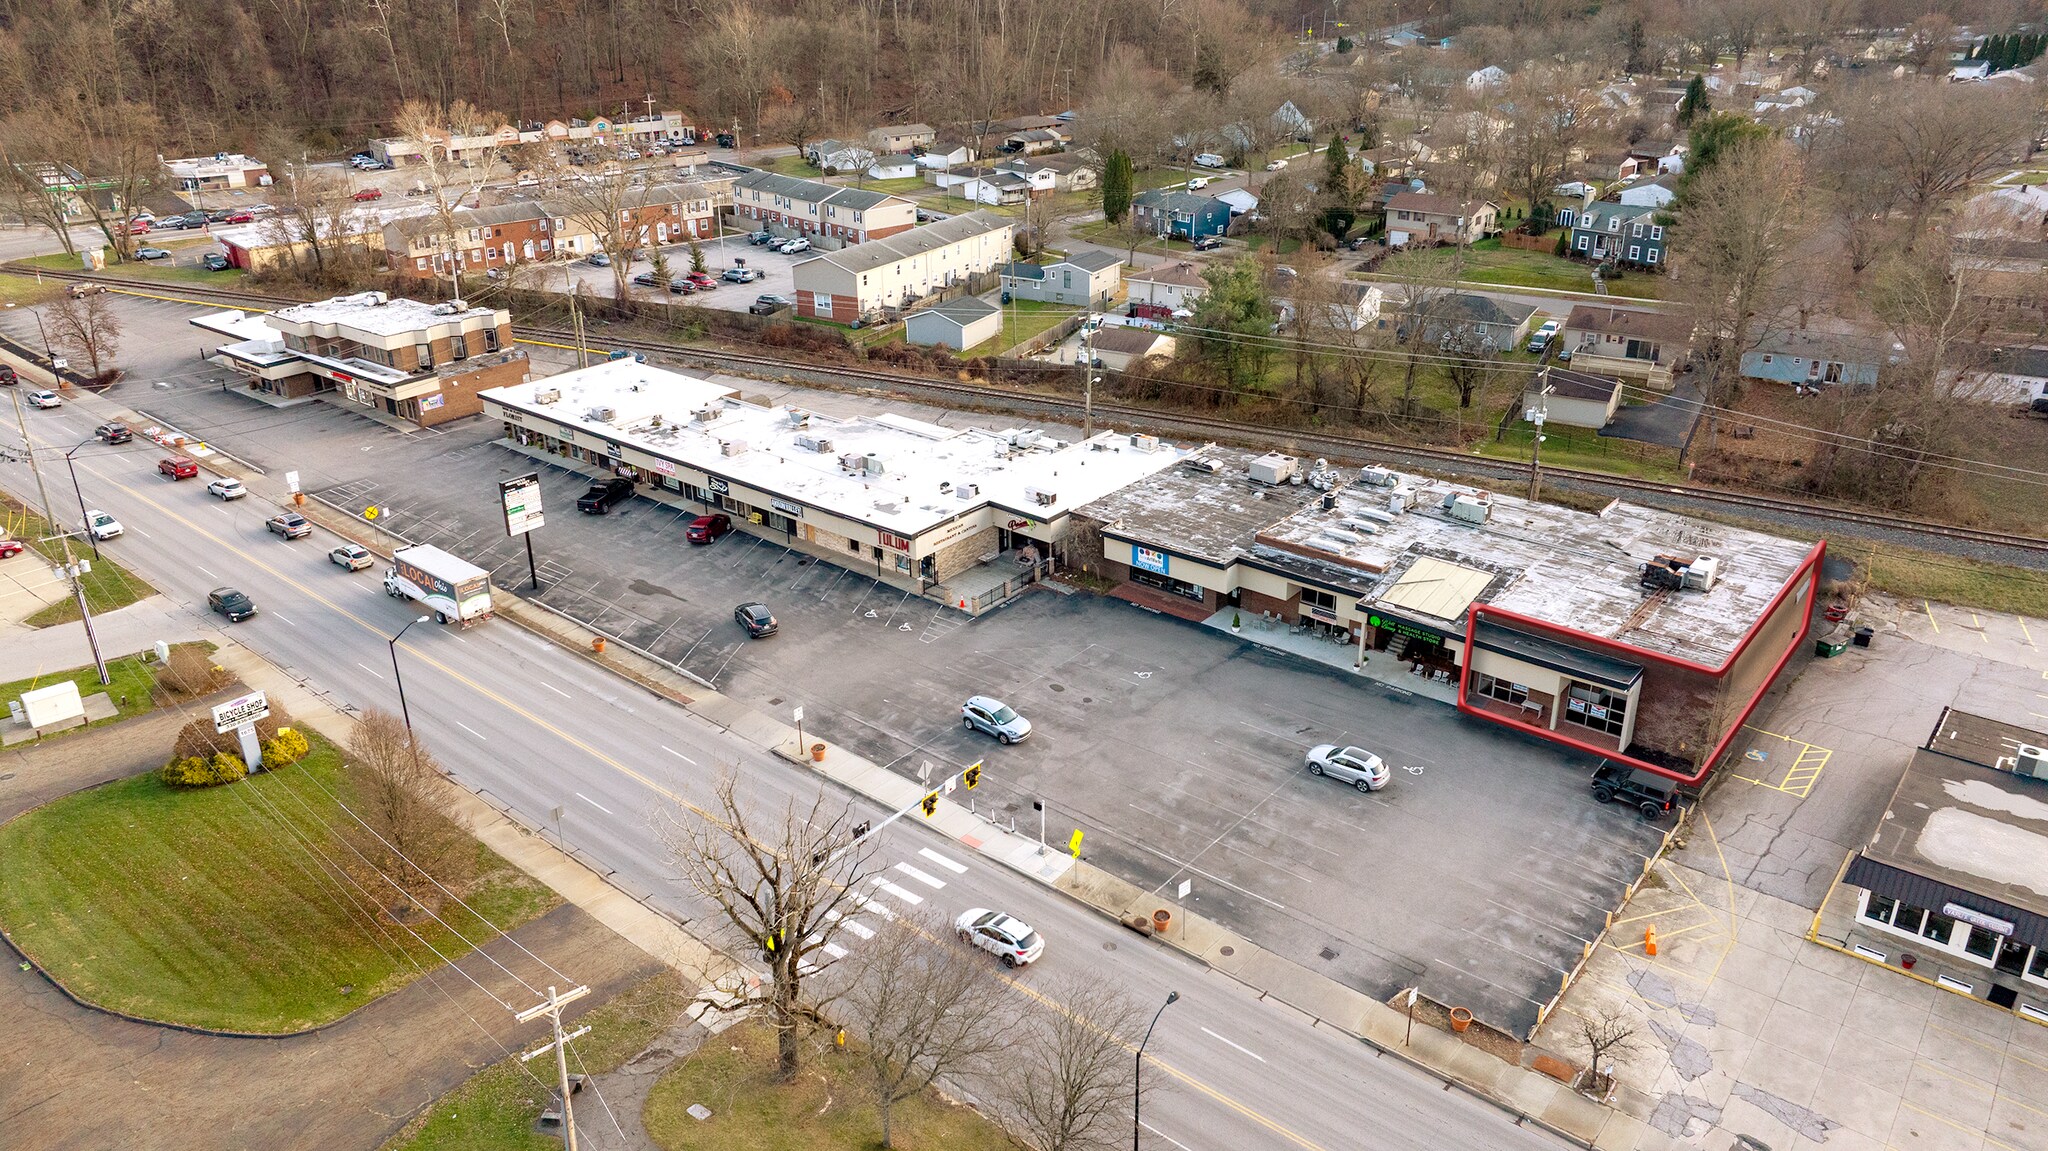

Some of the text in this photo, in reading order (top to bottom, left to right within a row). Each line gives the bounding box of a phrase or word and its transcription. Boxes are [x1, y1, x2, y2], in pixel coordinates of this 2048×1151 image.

[877, 530, 910, 553] TULUM
[1135, 560, 1166, 574] NOW OPEN
[403, 563, 439, 592] LOCAL
[1397, 624, 1441, 641] MASSAGE STUDIO
[1402, 630, 1422, 640] HEALTH
[1423, 636, 1440, 646] STORE
[1386, 685, 1413, 697] PARKING
[218, 705, 246, 721] BICYCLE
[246, 699, 263, 711] SHOP
